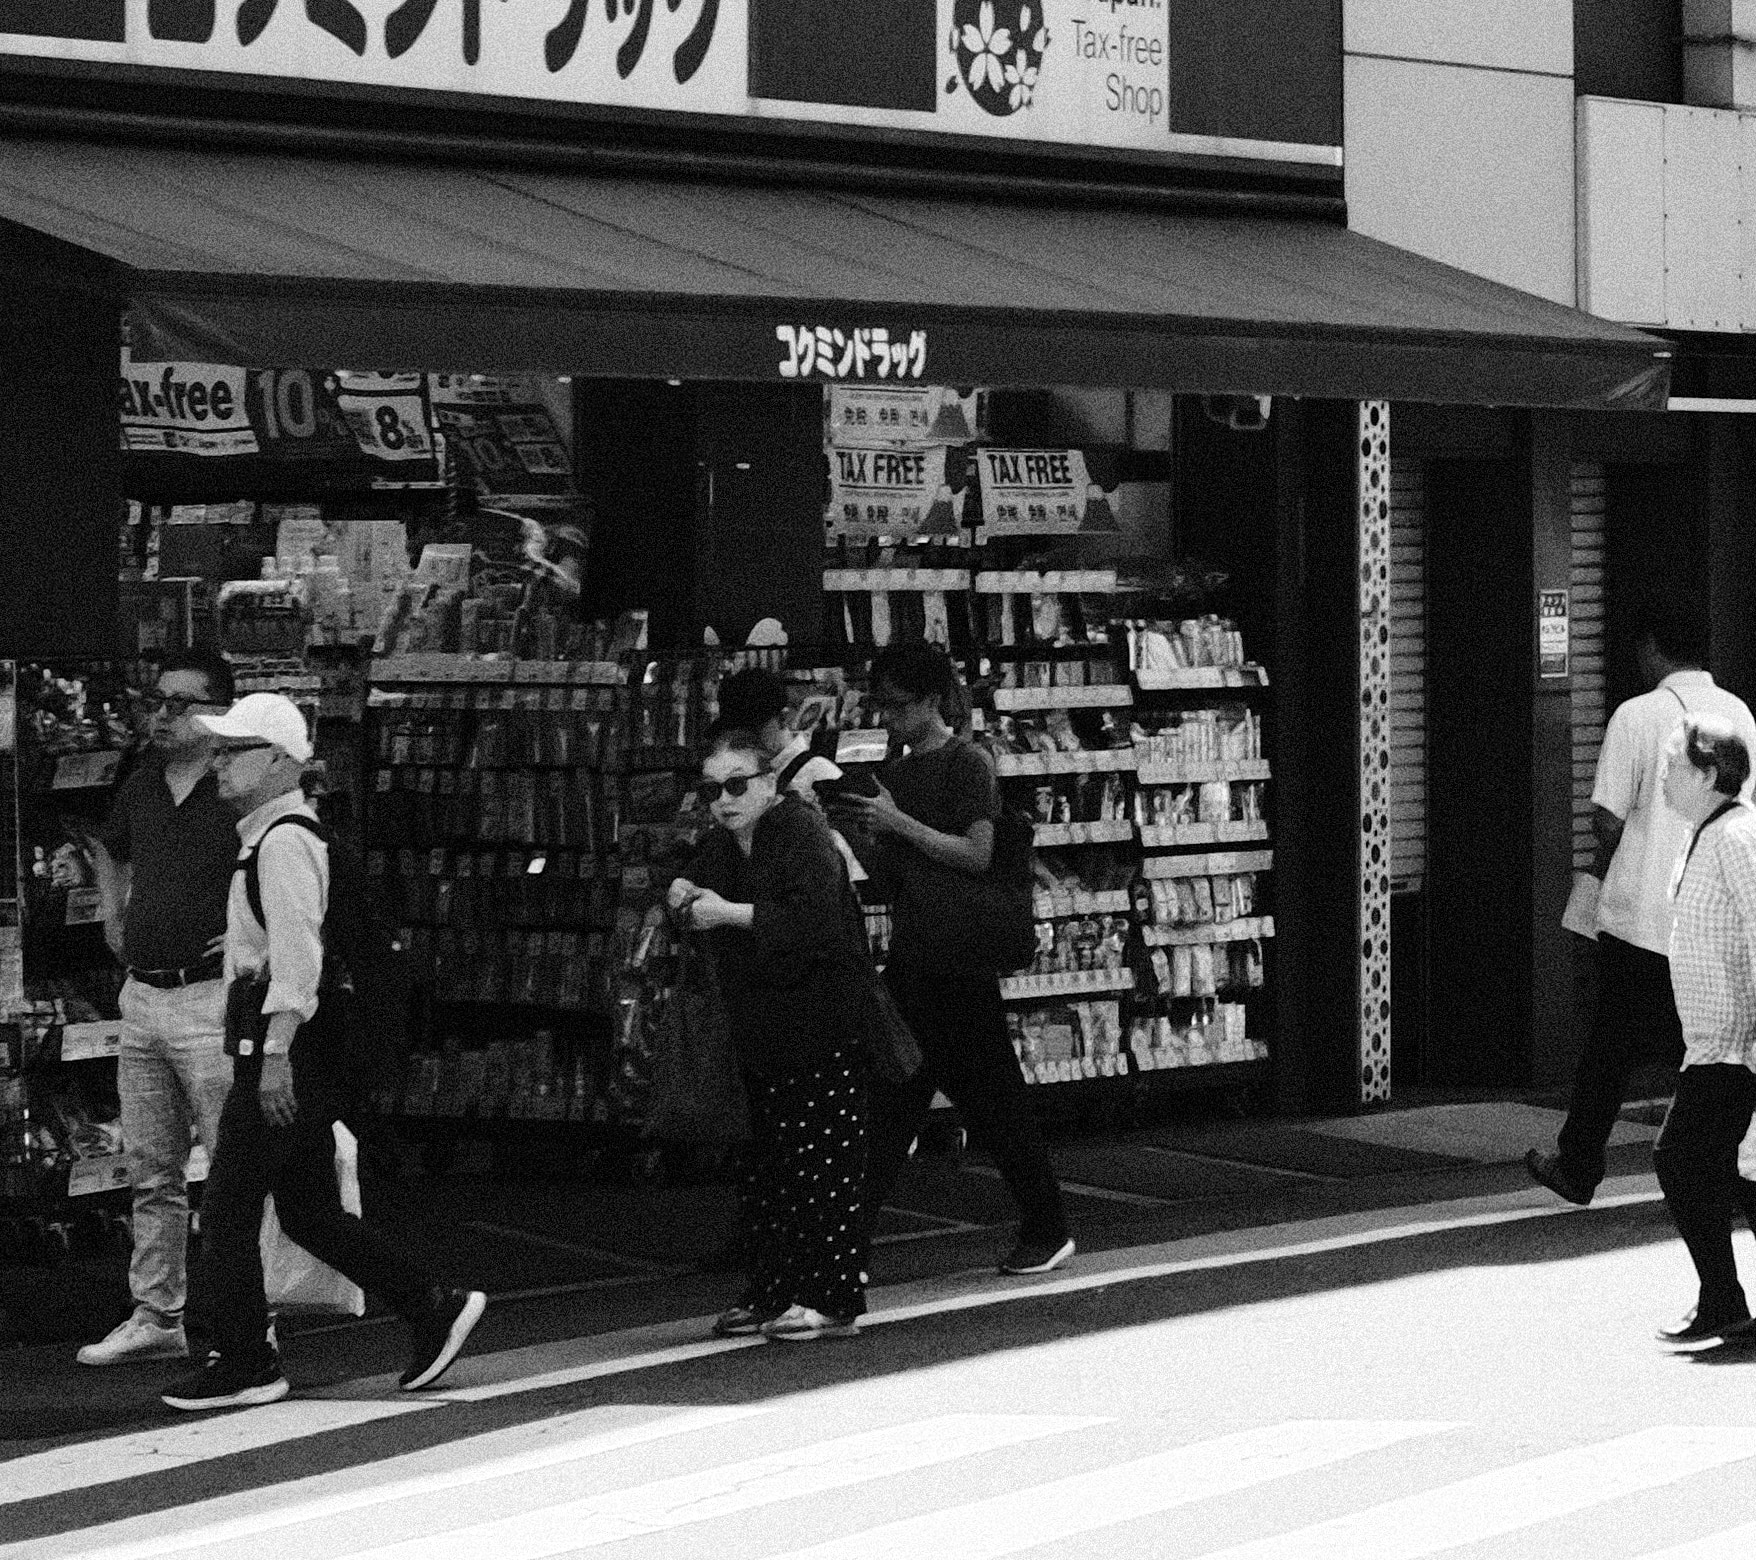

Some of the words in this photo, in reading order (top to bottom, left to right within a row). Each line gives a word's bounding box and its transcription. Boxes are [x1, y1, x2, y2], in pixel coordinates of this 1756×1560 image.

[1071, 18, 1163, 66] Tax-free
[1105, 71, 1163, 125] Shop
[776, 324, 928, 380] コクミンドラッグ
[119, 366, 234, 421] ax-free
[836, 451, 867, 484] TAX
[873, 453, 926, 485] FREE
[987, 454, 1022, 484] TAX
[1025, 455, 1073, 484] FREE
